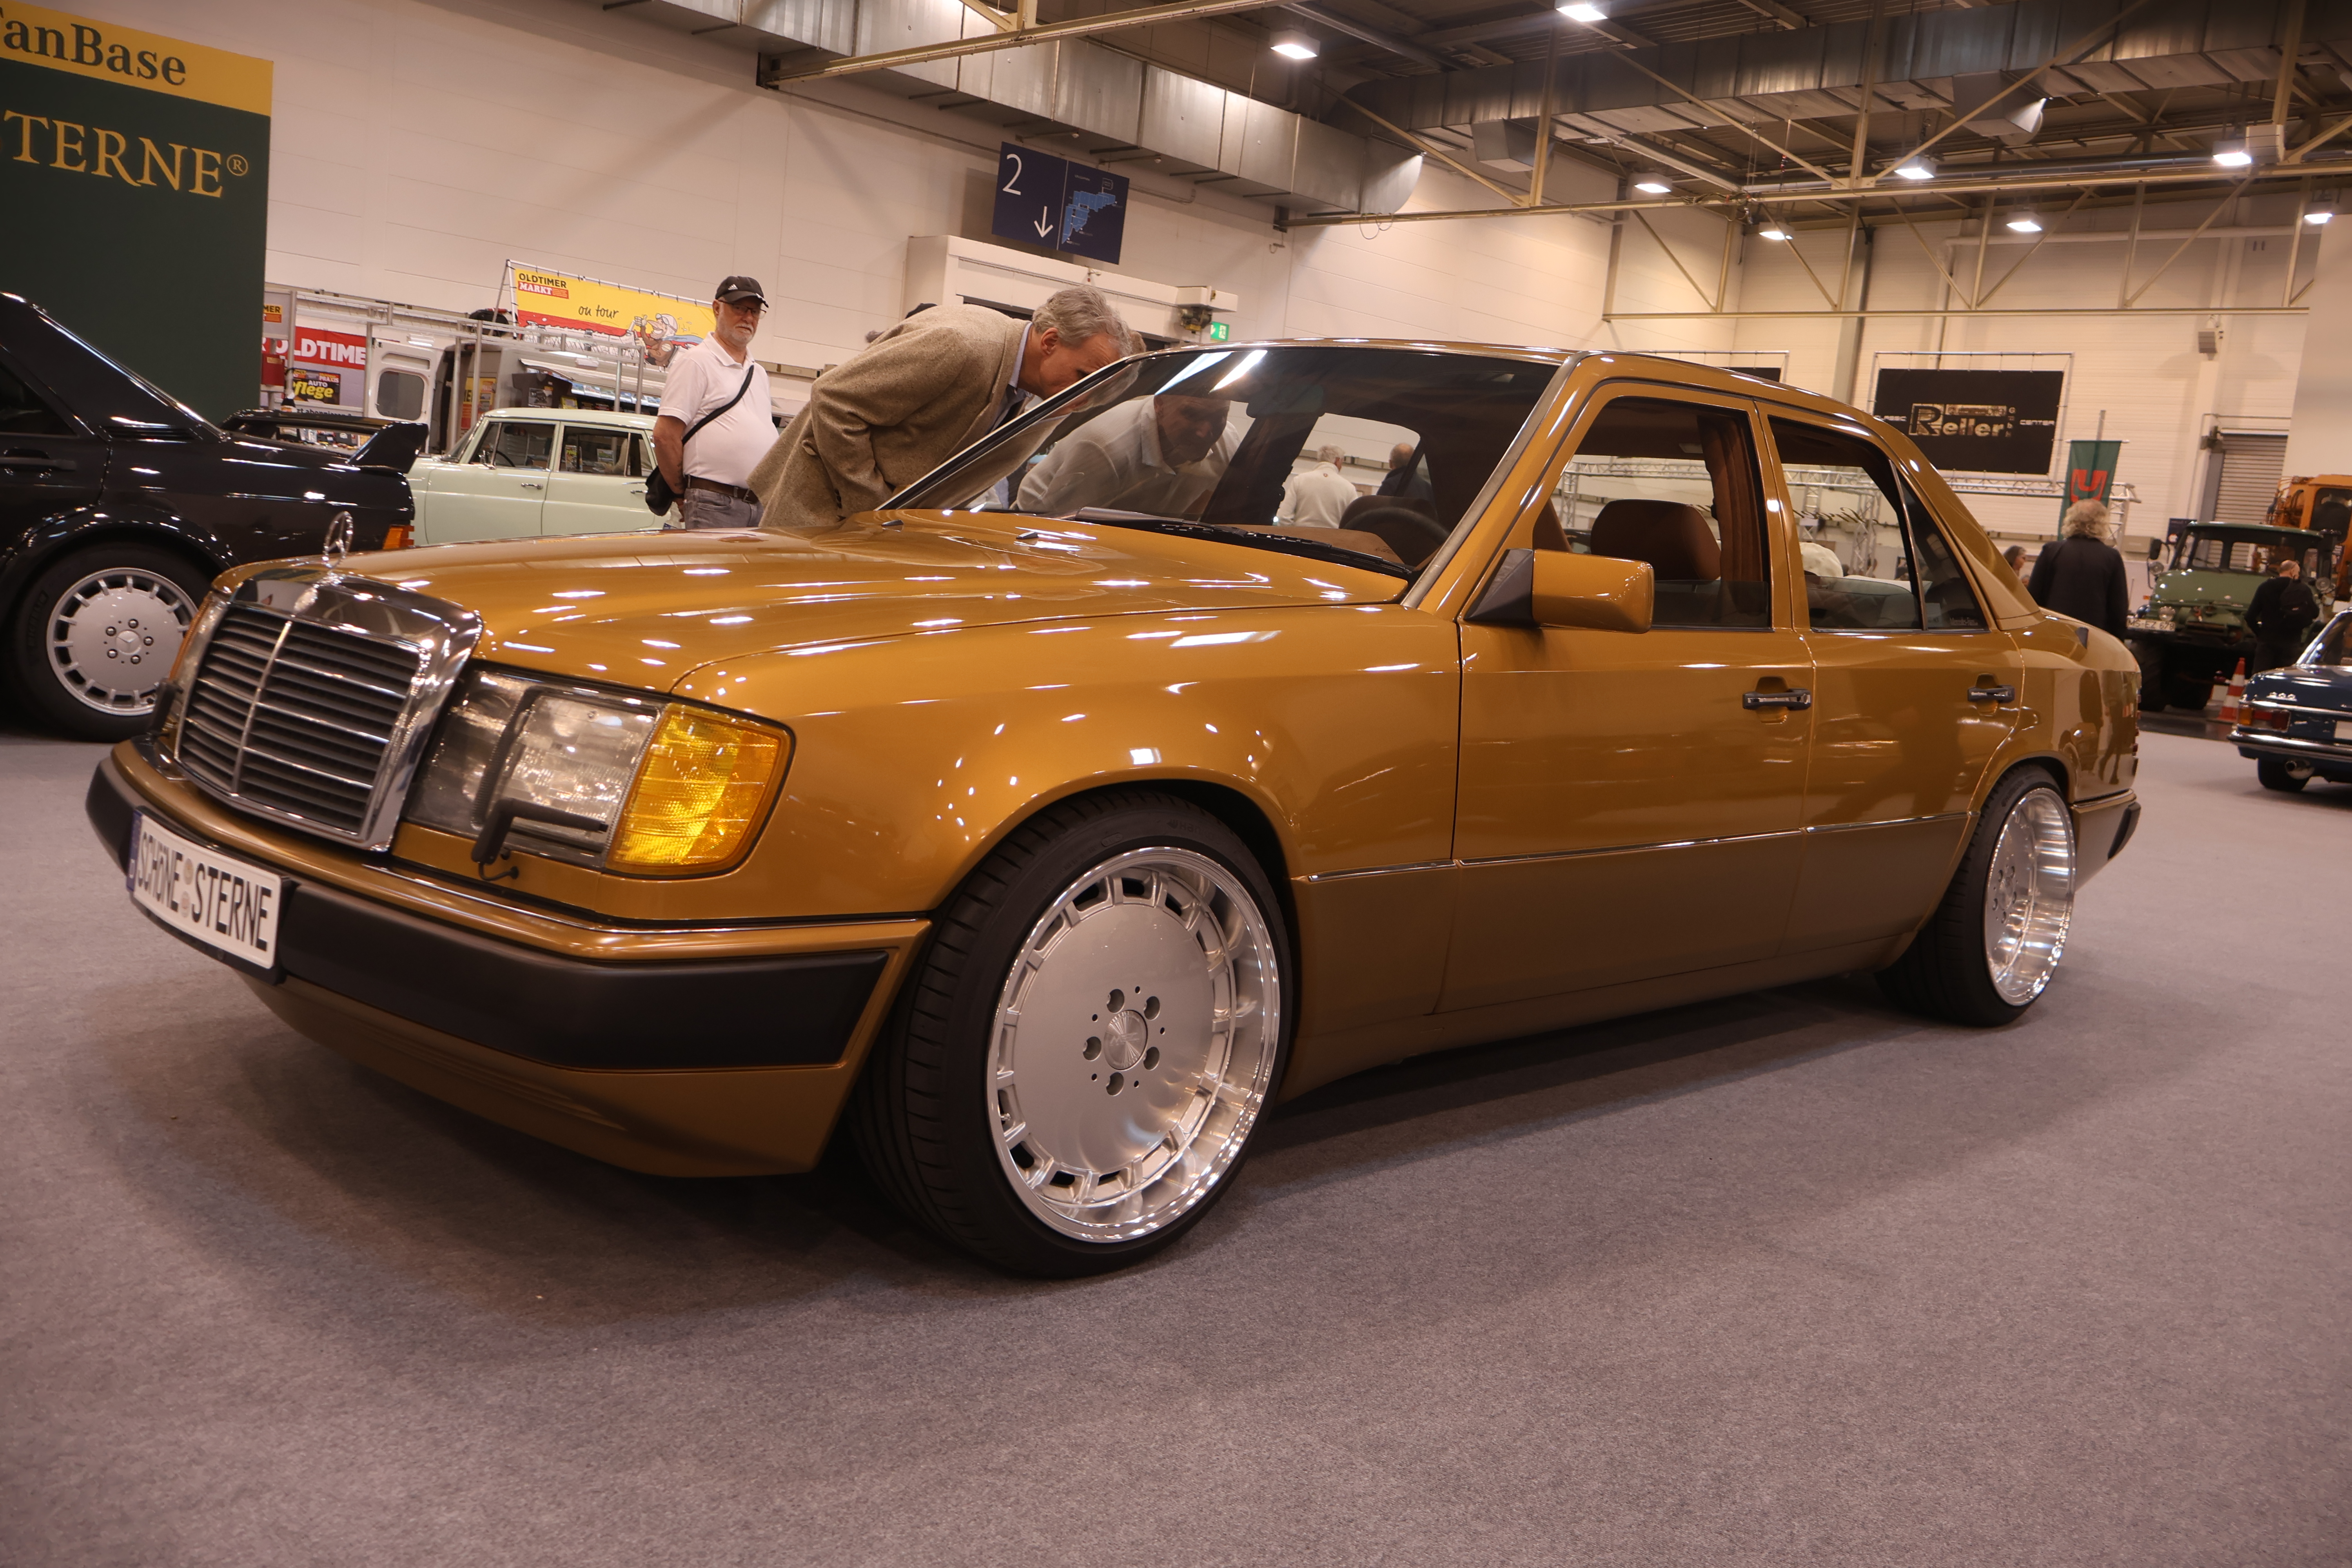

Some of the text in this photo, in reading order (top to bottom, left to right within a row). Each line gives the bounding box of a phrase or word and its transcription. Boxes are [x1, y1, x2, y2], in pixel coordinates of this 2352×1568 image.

[0, 7, 186, 85] anBase
[1002, 154, 1022, 195] 2
[519, 273, 567, 288] OLDTIMER
[519, 282, 552, 295] MARKT
[578, 305, 619, 319] on tour
[276, 338, 367, 365] ODTIME
[137, 831, 272, 952] SCHÖNE STERNE
